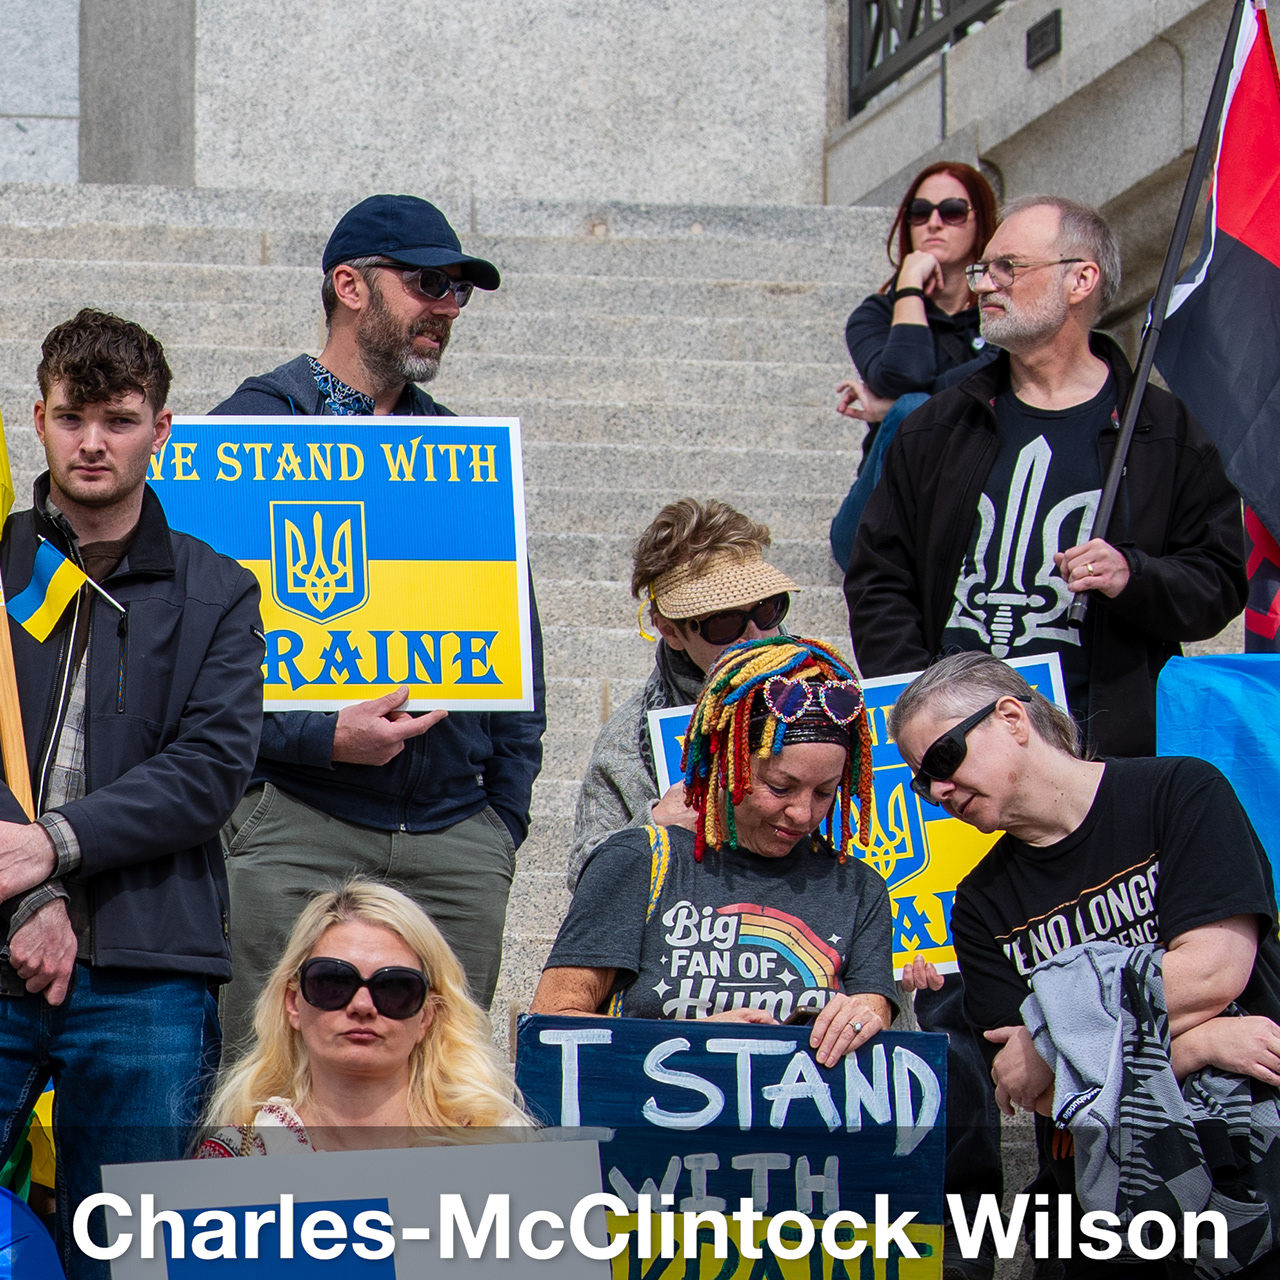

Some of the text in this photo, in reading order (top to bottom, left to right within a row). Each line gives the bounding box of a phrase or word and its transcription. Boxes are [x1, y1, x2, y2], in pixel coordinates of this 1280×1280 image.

[214, 441, 366, 482] STAND
[380, 433, 499, 483] WITH
[262, 629, 504, 692] RAINE
[661, 900, 739, 950] Big
[1028, 914, 1072, 966] NO
[670, 949, 778, 979] FAN OF
[540, 1028, 943, 1157] I STAND
[608, 1151, 840, 1214] WITH
